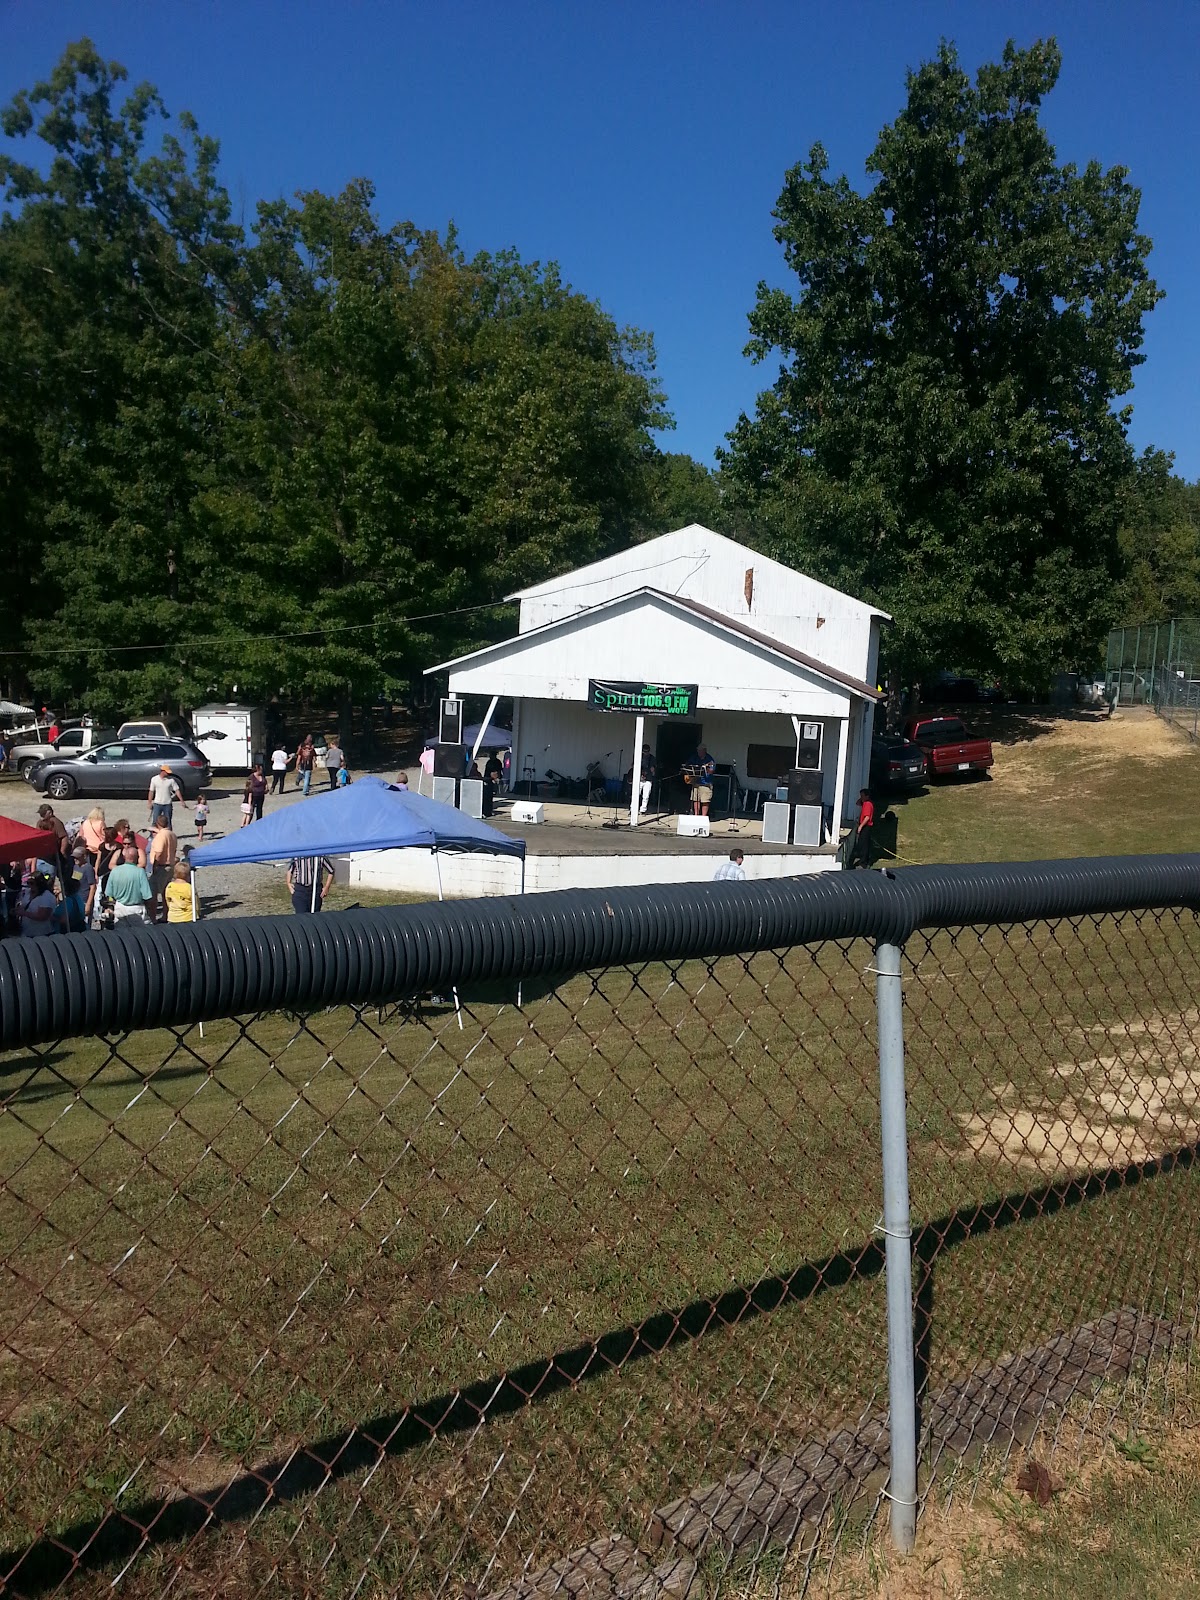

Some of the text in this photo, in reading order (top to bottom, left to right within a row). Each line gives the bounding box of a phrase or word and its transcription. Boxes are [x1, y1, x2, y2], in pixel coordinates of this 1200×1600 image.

[594, 689, 689, 708] Spirit 106.9 FM
